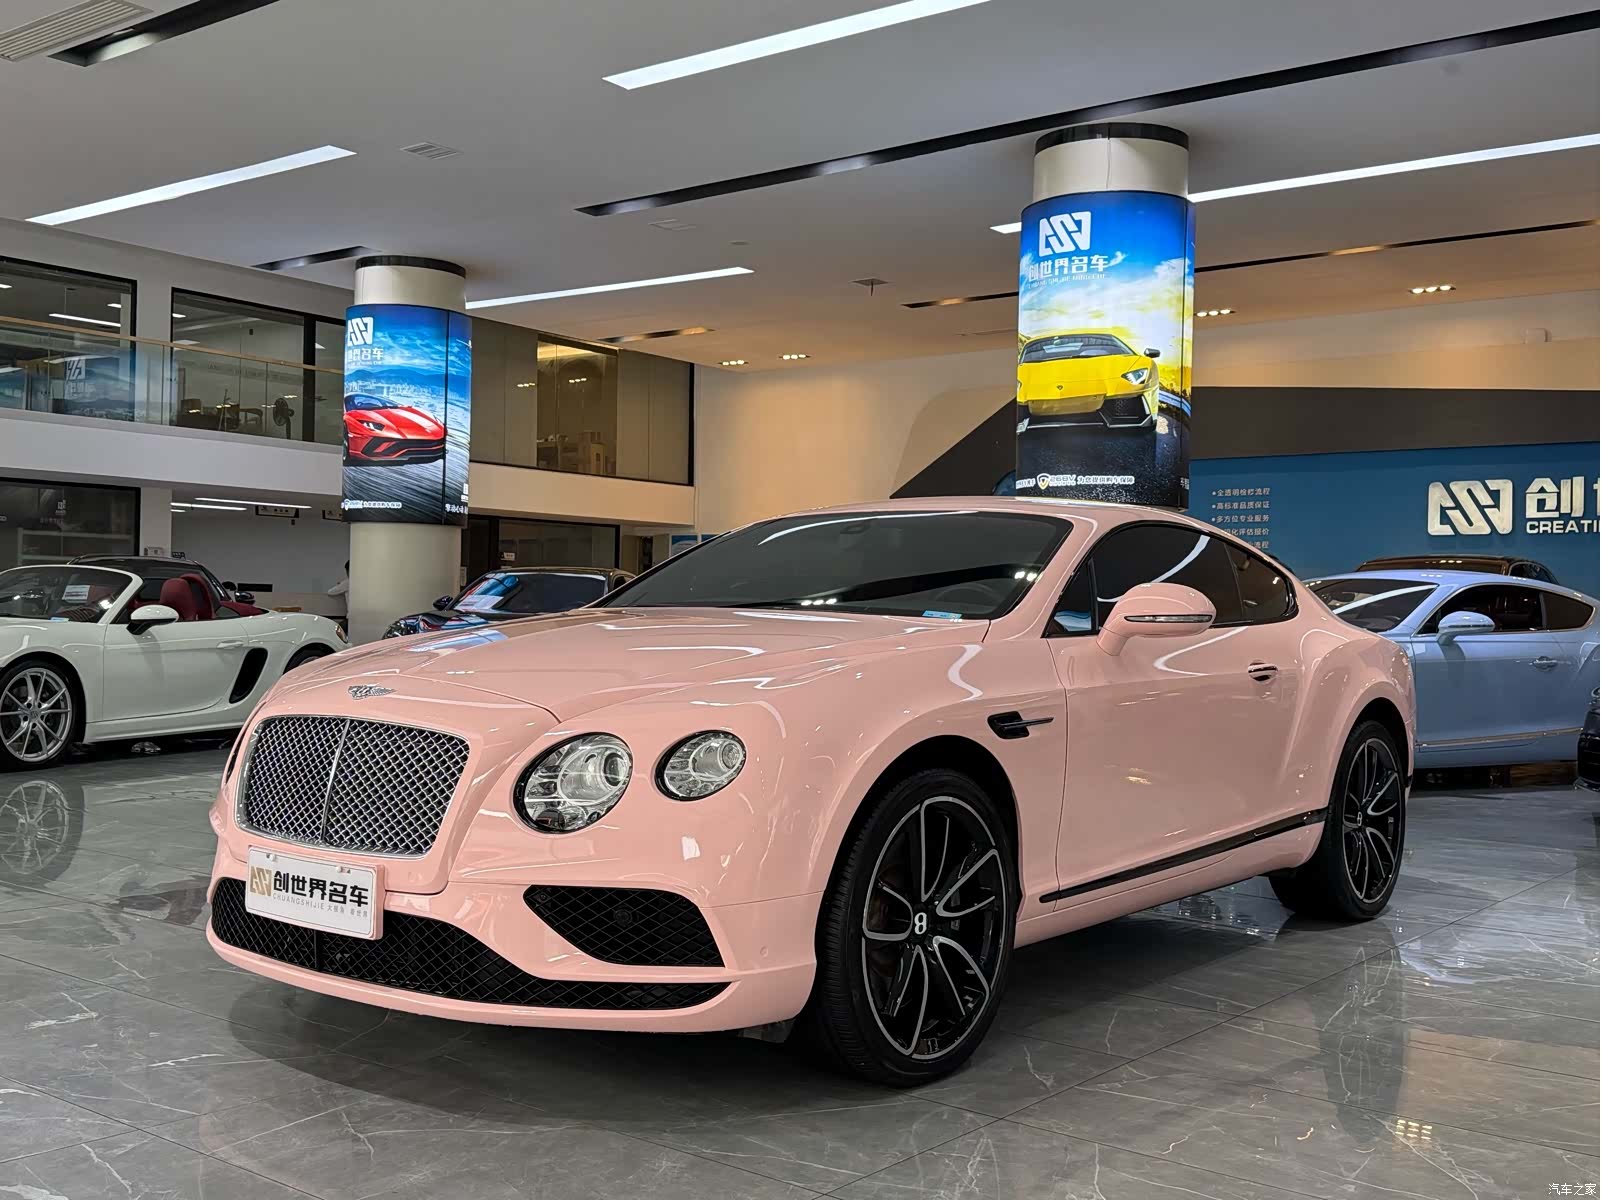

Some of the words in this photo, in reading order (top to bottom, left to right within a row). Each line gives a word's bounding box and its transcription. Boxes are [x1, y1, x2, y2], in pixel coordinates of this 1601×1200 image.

[1028, 254, 1109, 282] 创世界名车
[1217, 487, 1270, 497] 全透明检修流程
[1525, 476, 1600, 518] 创
[1216, 501, 1270, 510] 高标准品质保证
[1216, 515, 1270, 523] 多方位专业服务
[1526, 520, 1600, 534] CREATI
[273, 870, 369, 908] 创世界名车
[272, 892, 325, 910] CHUANGSHIJIE
